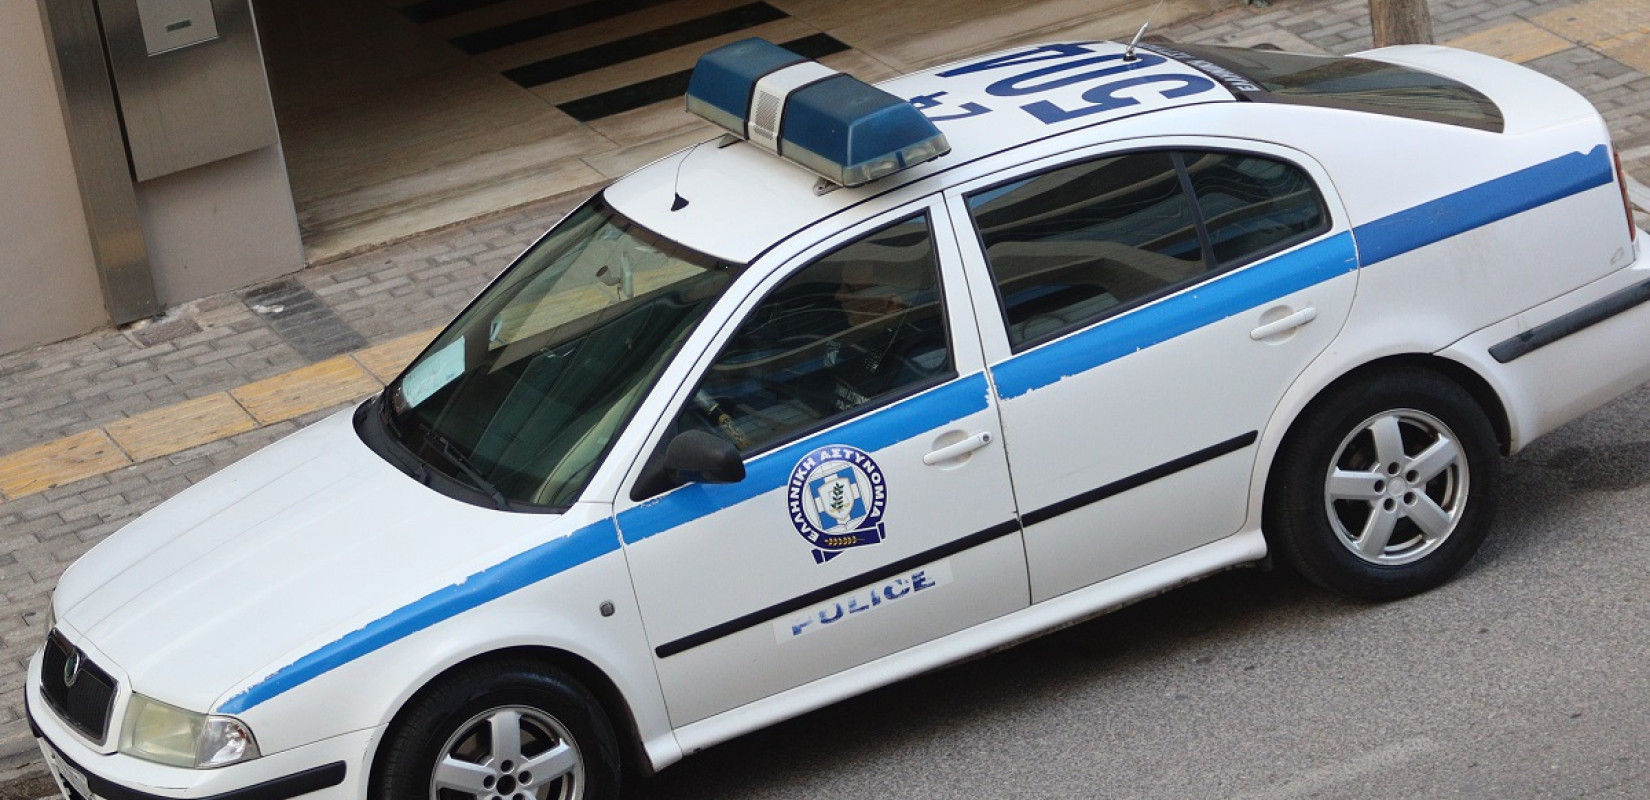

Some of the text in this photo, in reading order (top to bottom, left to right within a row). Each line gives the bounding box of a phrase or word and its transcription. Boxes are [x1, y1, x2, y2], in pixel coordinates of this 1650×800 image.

[934, 41, 1216, 125] 504
[790, 448, 885, 543] ΕΛΛΗΝΙΚΗ ΑΣΤΥΝΟΜΙΑ
